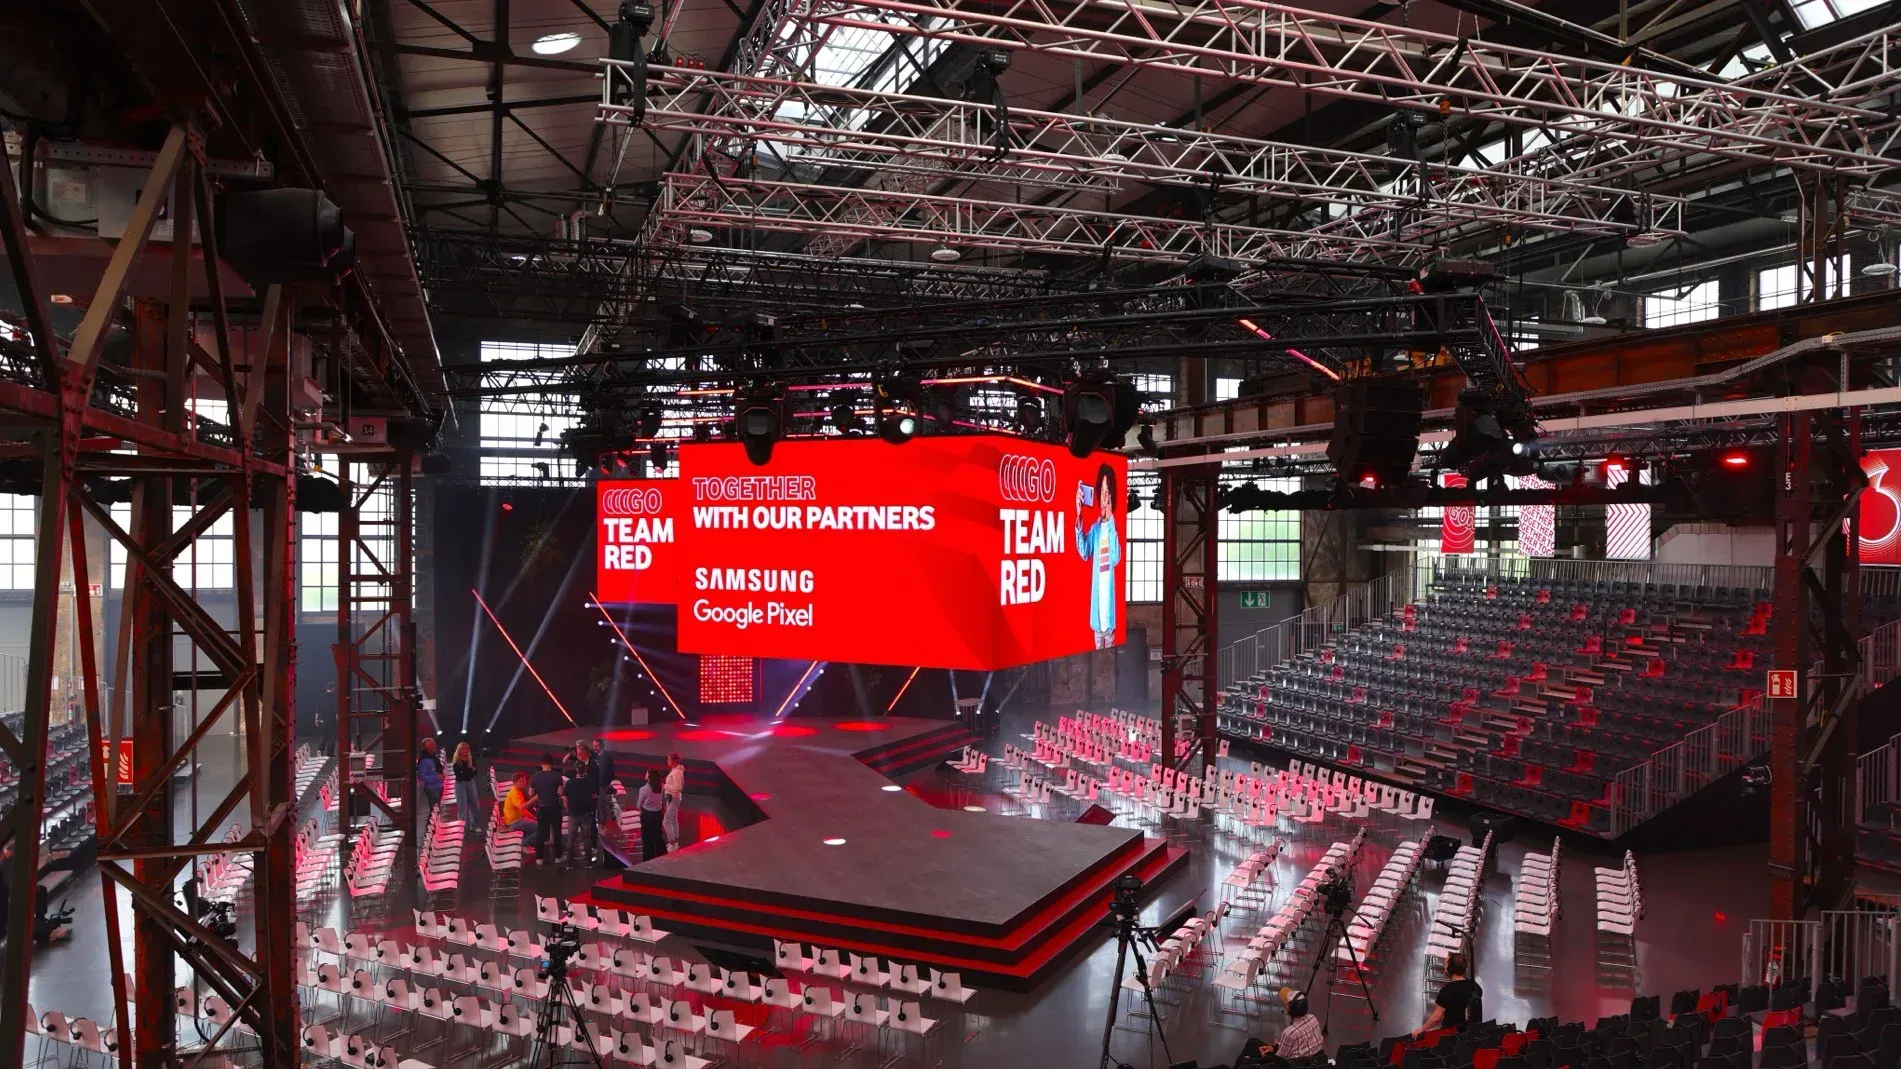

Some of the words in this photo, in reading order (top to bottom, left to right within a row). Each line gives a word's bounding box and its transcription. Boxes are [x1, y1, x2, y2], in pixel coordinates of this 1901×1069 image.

[692, 476, 816, 500] TOGETHER
[603, 517, 675, 543] TEAM
[692, 506, 748, 529] WITH
[752, 506, 802, 529] OUR
[807, 505, 936, 530] PARTNERS
[1000, 508, 1065, 554] TEAM
[604, 544, 653, 570] RED
[695, 567, 814, 593] SAMSUNG
[1000, 558, 1046, 606] RED
[693, 599, 763, 629] Google
[767, 602, 813, 627] Pixel
